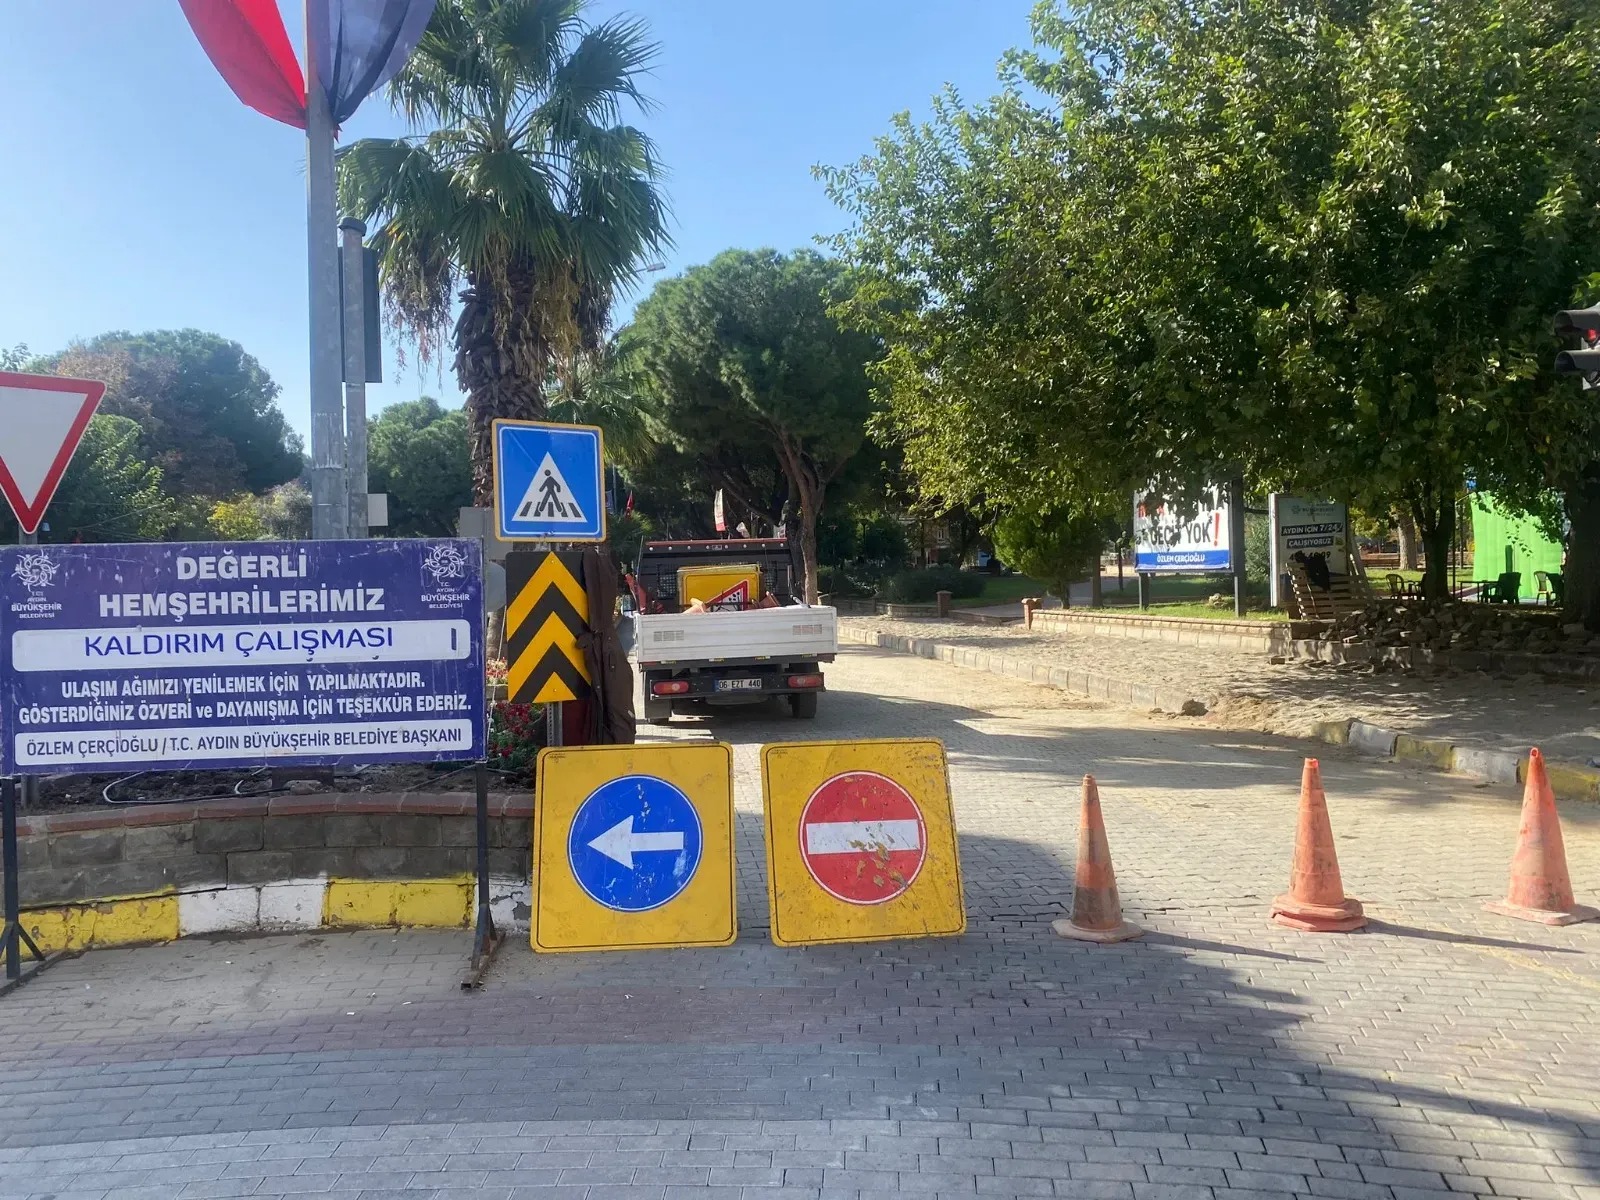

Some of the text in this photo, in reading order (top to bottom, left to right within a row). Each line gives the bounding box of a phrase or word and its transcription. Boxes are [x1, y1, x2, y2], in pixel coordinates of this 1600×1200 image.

[177, 548, 307, 580] DEĞERLİ
[1156, 552, 1205, 564] ÖZLEM ÇERÇİOĞLU
[11, 602, 62, 613] BÜYÜKŞEHİR
[100, 581, 385, 622] HEMŞEHRİLERİMİZ
[421, 593, 470, 603] BÜYÜKŞEHİR
[85, 627, 393, 658] KALDIRIM ÇALIŞMASI
[62, 671, 425, 700] ULAŞIM AĞIMIZI YENİLEMEK İÇİN YAPILMAKTADIR.
[19, 690, 472, 724] GÖSTERDİĞİNİZ ÖZVERİ ve DAYANIŞMA İÇİN TEŞEKKÜR EDERİZ.
[27, 739, 74, 756] ÖZLEM
[78, 735, 158, 758] ÇERÇİOĞLU
[170, 737, 193, 751] T.C.
[197, 736, 239, 750] AYDIN
[243, 730, 330, 751] BÜYÜKŞEHİR
[334, 727, 398, 746] BELEDİYE
[402, 727, 462, 746] BAŞKANI
